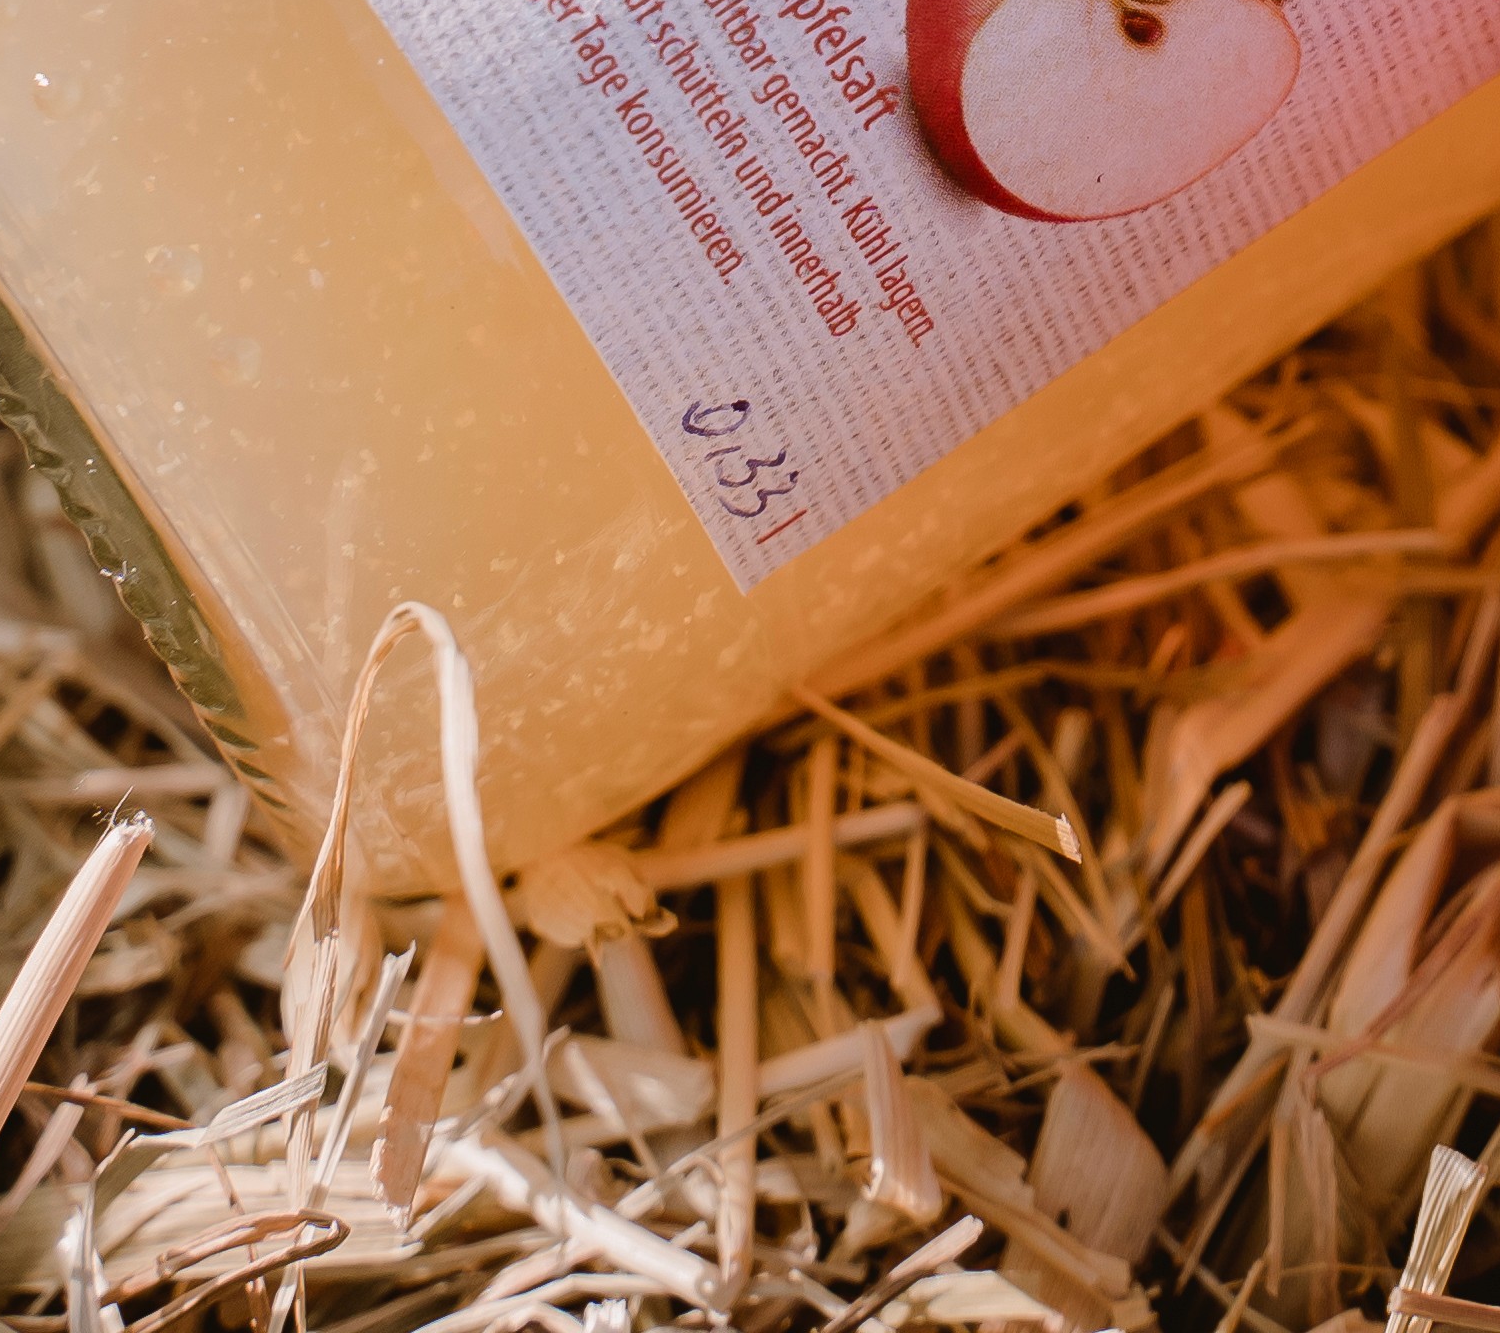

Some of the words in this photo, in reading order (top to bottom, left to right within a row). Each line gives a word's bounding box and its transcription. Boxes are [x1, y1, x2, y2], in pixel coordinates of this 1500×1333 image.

[570, 12, 630, 99] Tage
[614, 88, 746, 287] konsumieren.
[647, 20, 749, 160] schütteln
[733, 154, 793, 217] und
[770, 206, 867, 338] innerhalb
[752, 74, 853, 206] gemacht.
[841, 196, 891, 265] Kühl
[879, 254, 936, 349] lagern.
